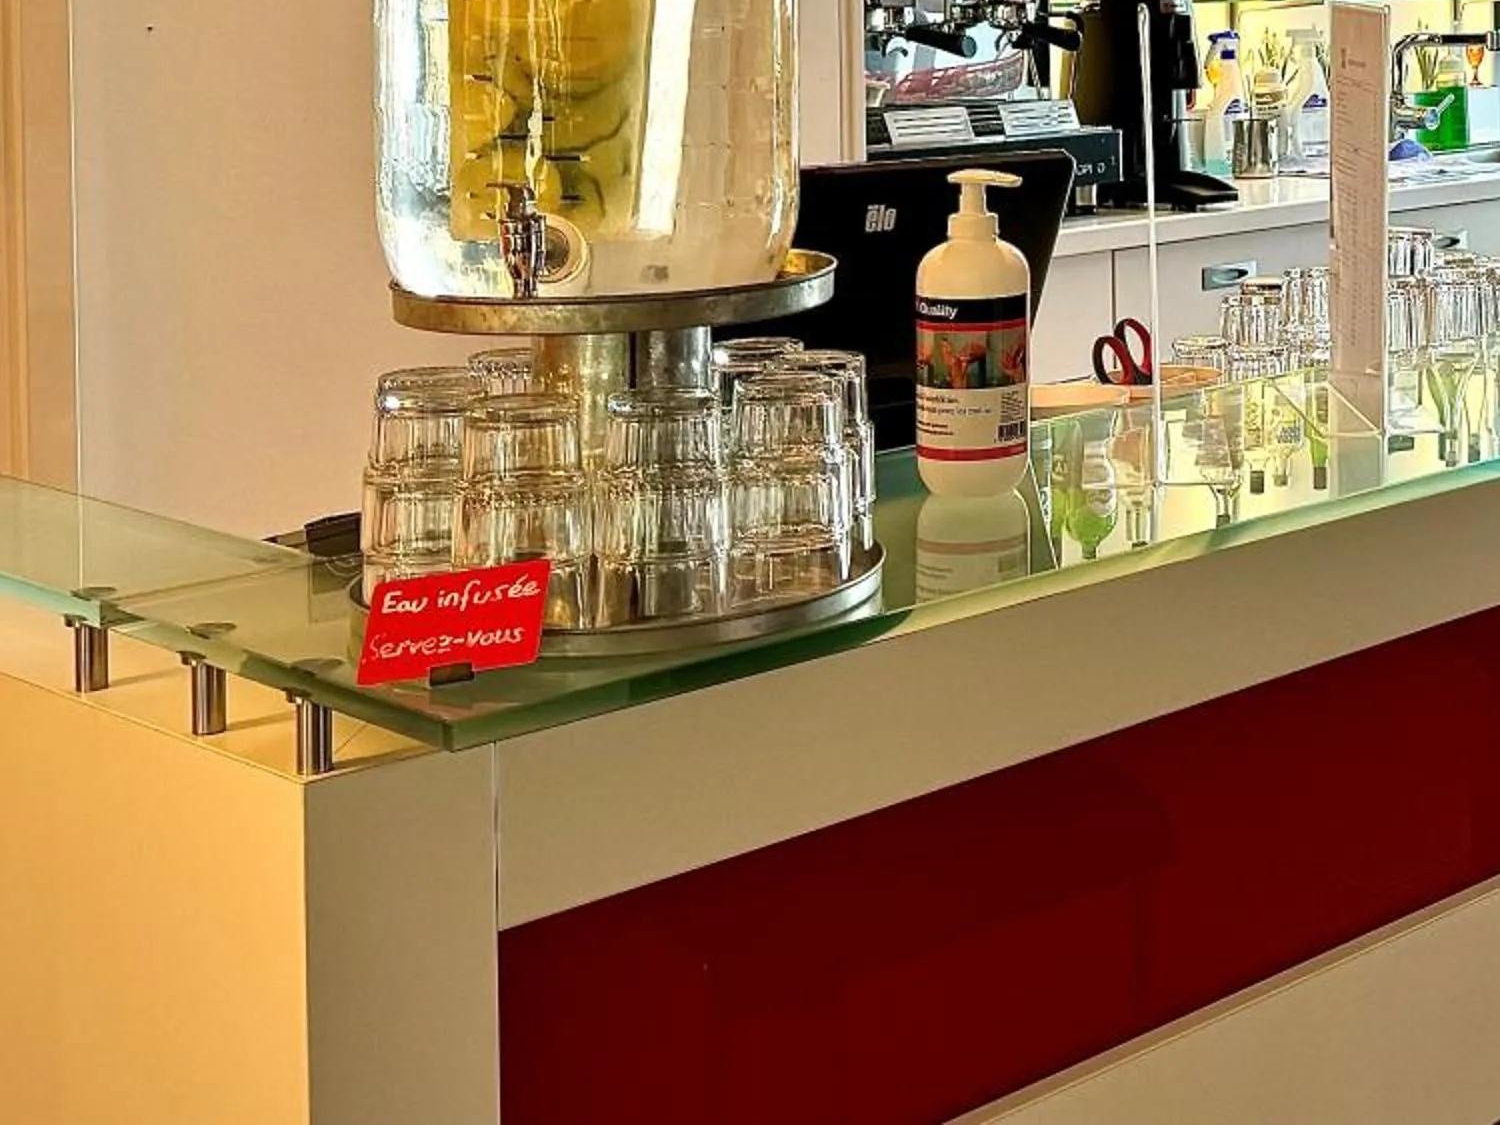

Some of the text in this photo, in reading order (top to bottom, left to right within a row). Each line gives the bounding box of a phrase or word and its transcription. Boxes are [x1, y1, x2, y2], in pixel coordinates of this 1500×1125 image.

[919, 302, 959, 320] Quality
[381, 573, 541, 614] Eau infusée
